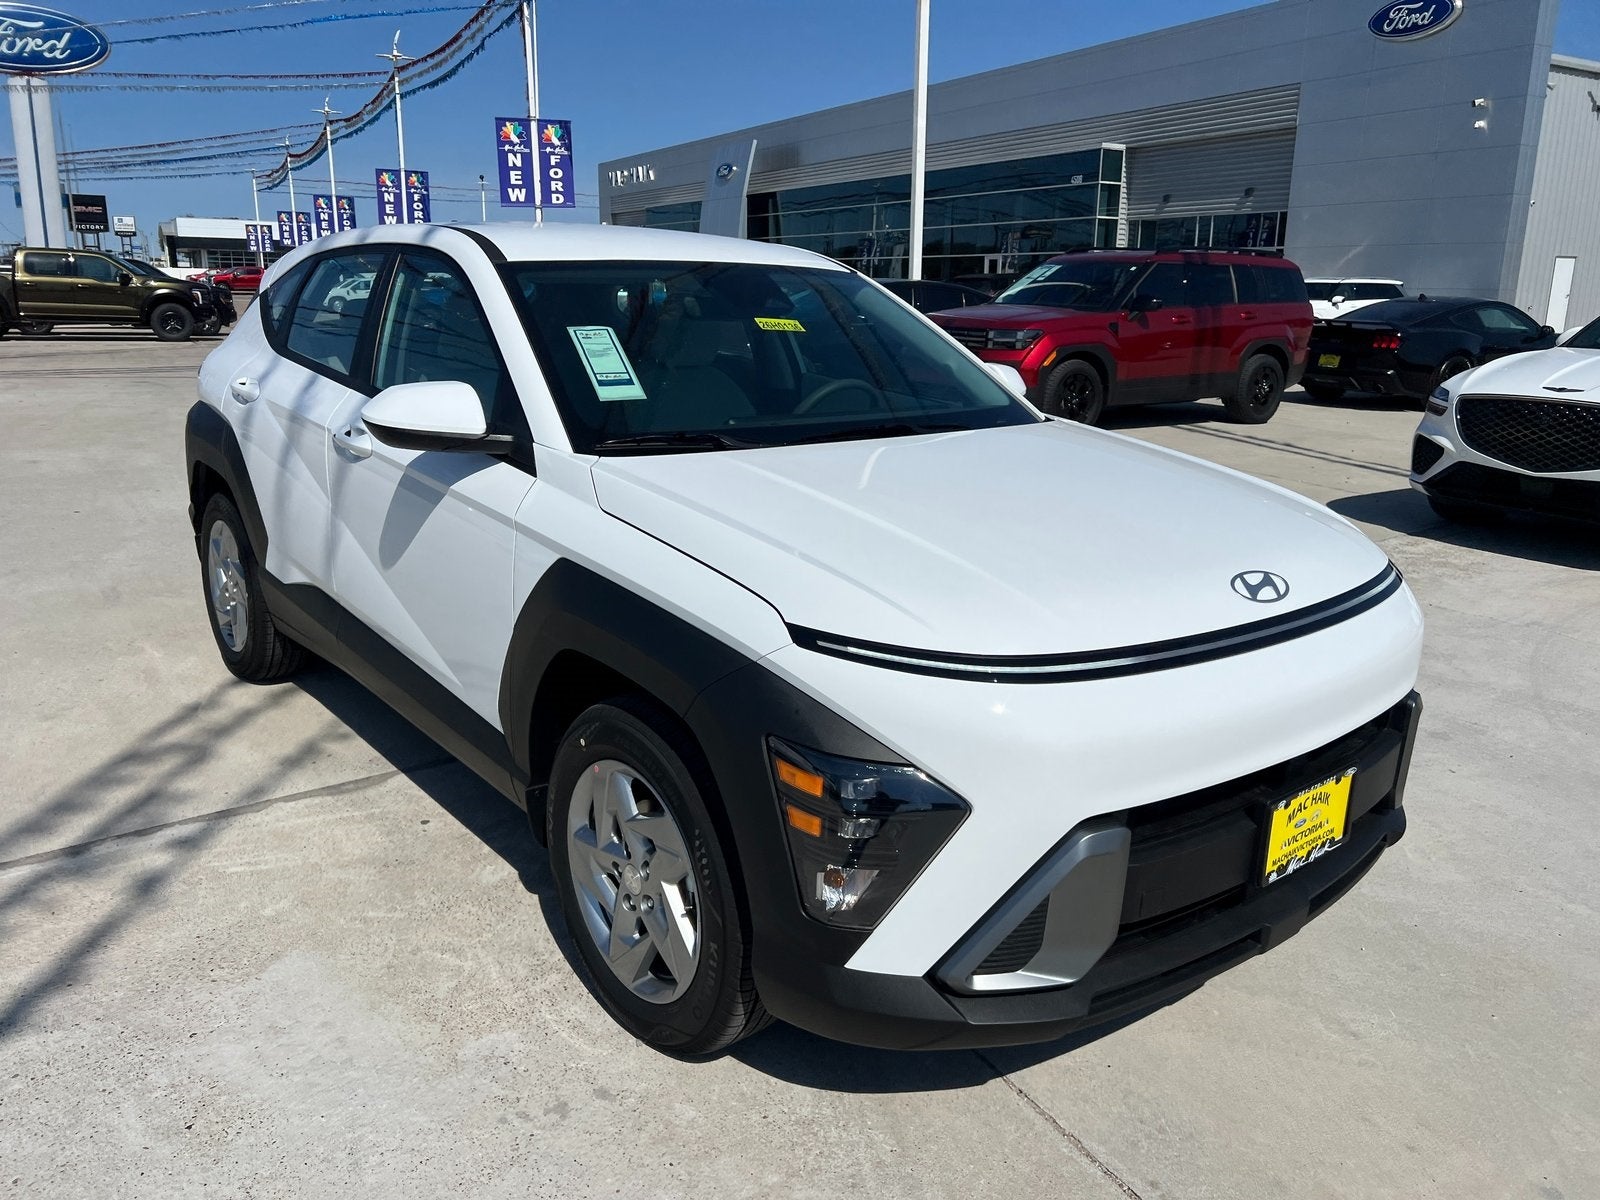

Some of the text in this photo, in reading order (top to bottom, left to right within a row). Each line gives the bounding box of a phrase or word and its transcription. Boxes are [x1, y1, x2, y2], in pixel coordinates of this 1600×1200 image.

[1383, 2, 1436, 32] Ford
[507, 152, 527, 202] NEW
[549, 155, 565, 204] FORD
[383, 192, 398, 224] NEW
[282, 225, 292, 245] NEW
[320, 212, 331, 237] NEW
[1286, 797, 1310, 828] MAC
[1310, 791, 1331, 807] HAIK
[1287, 820, 1323, 848] VICTORIA
